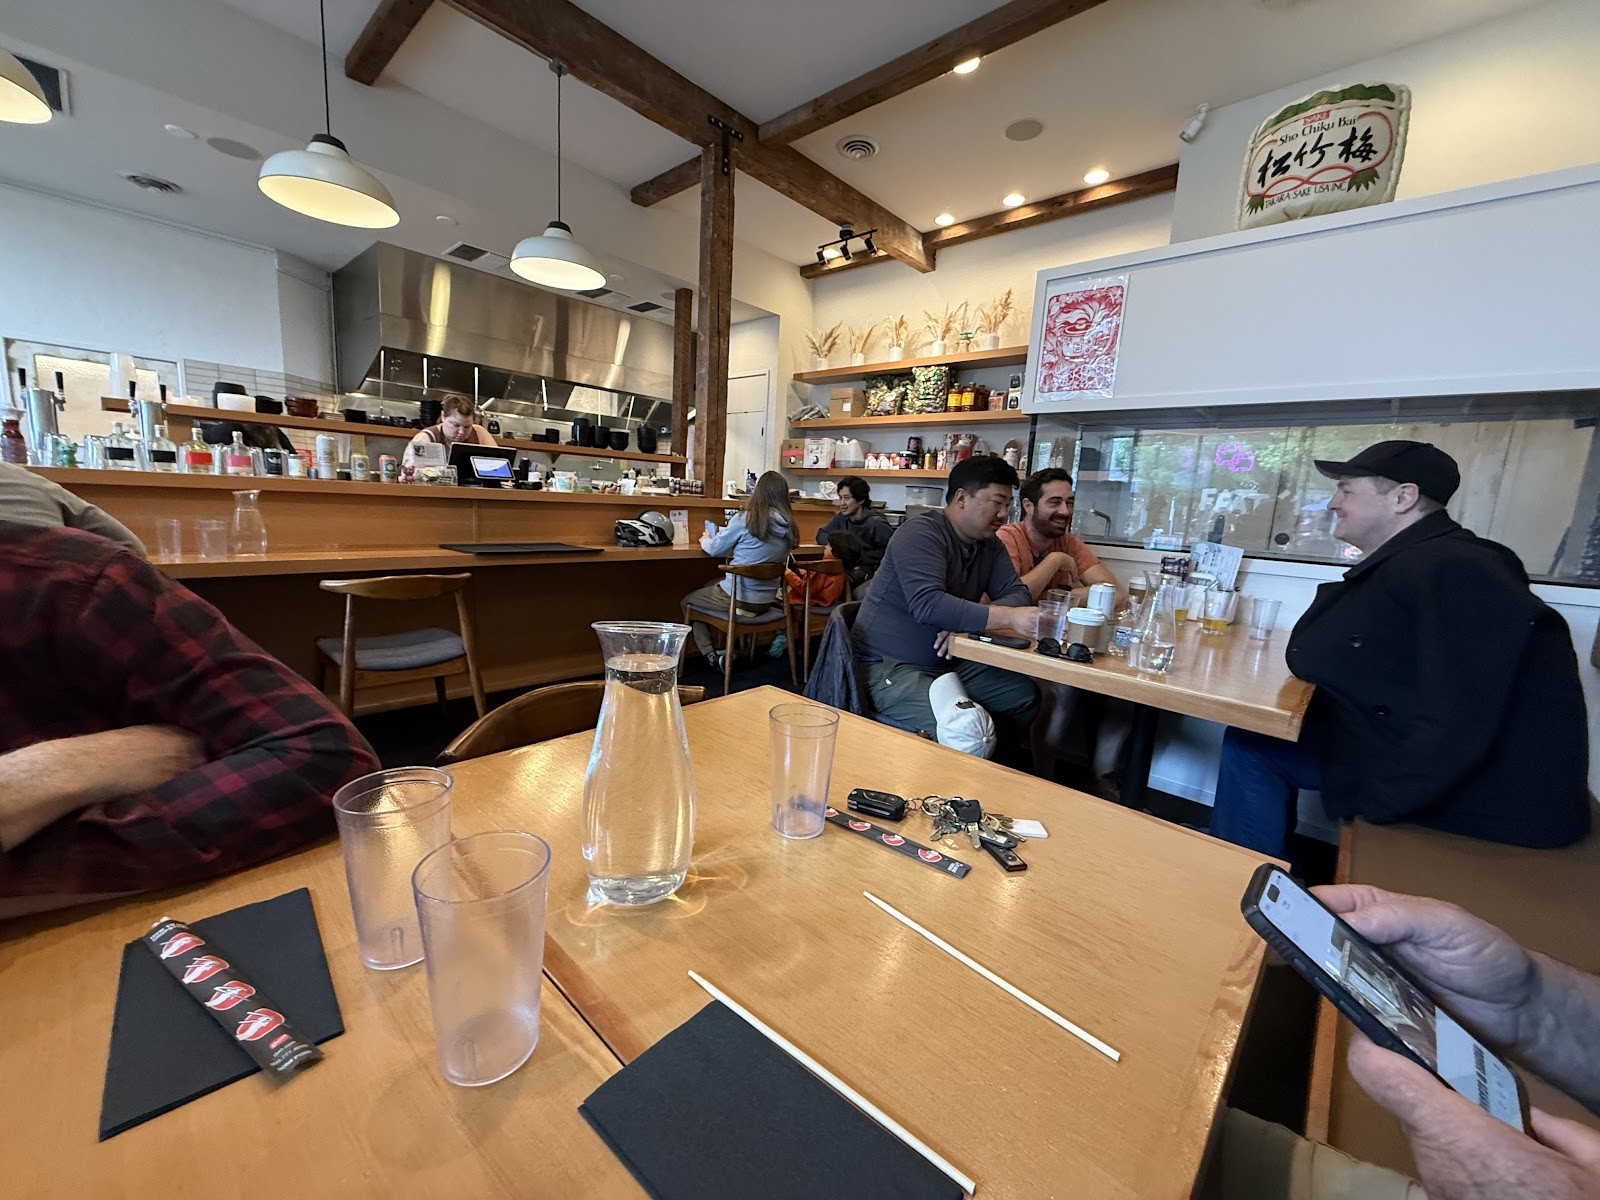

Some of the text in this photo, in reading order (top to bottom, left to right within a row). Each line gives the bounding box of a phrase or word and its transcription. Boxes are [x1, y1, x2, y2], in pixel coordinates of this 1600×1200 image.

[1279, 115, 1356, 146] Sho Chiku Bai
[1265, 193, 1291, 208] TAKARA
[1293, 188, 1311, 199] SAKE
